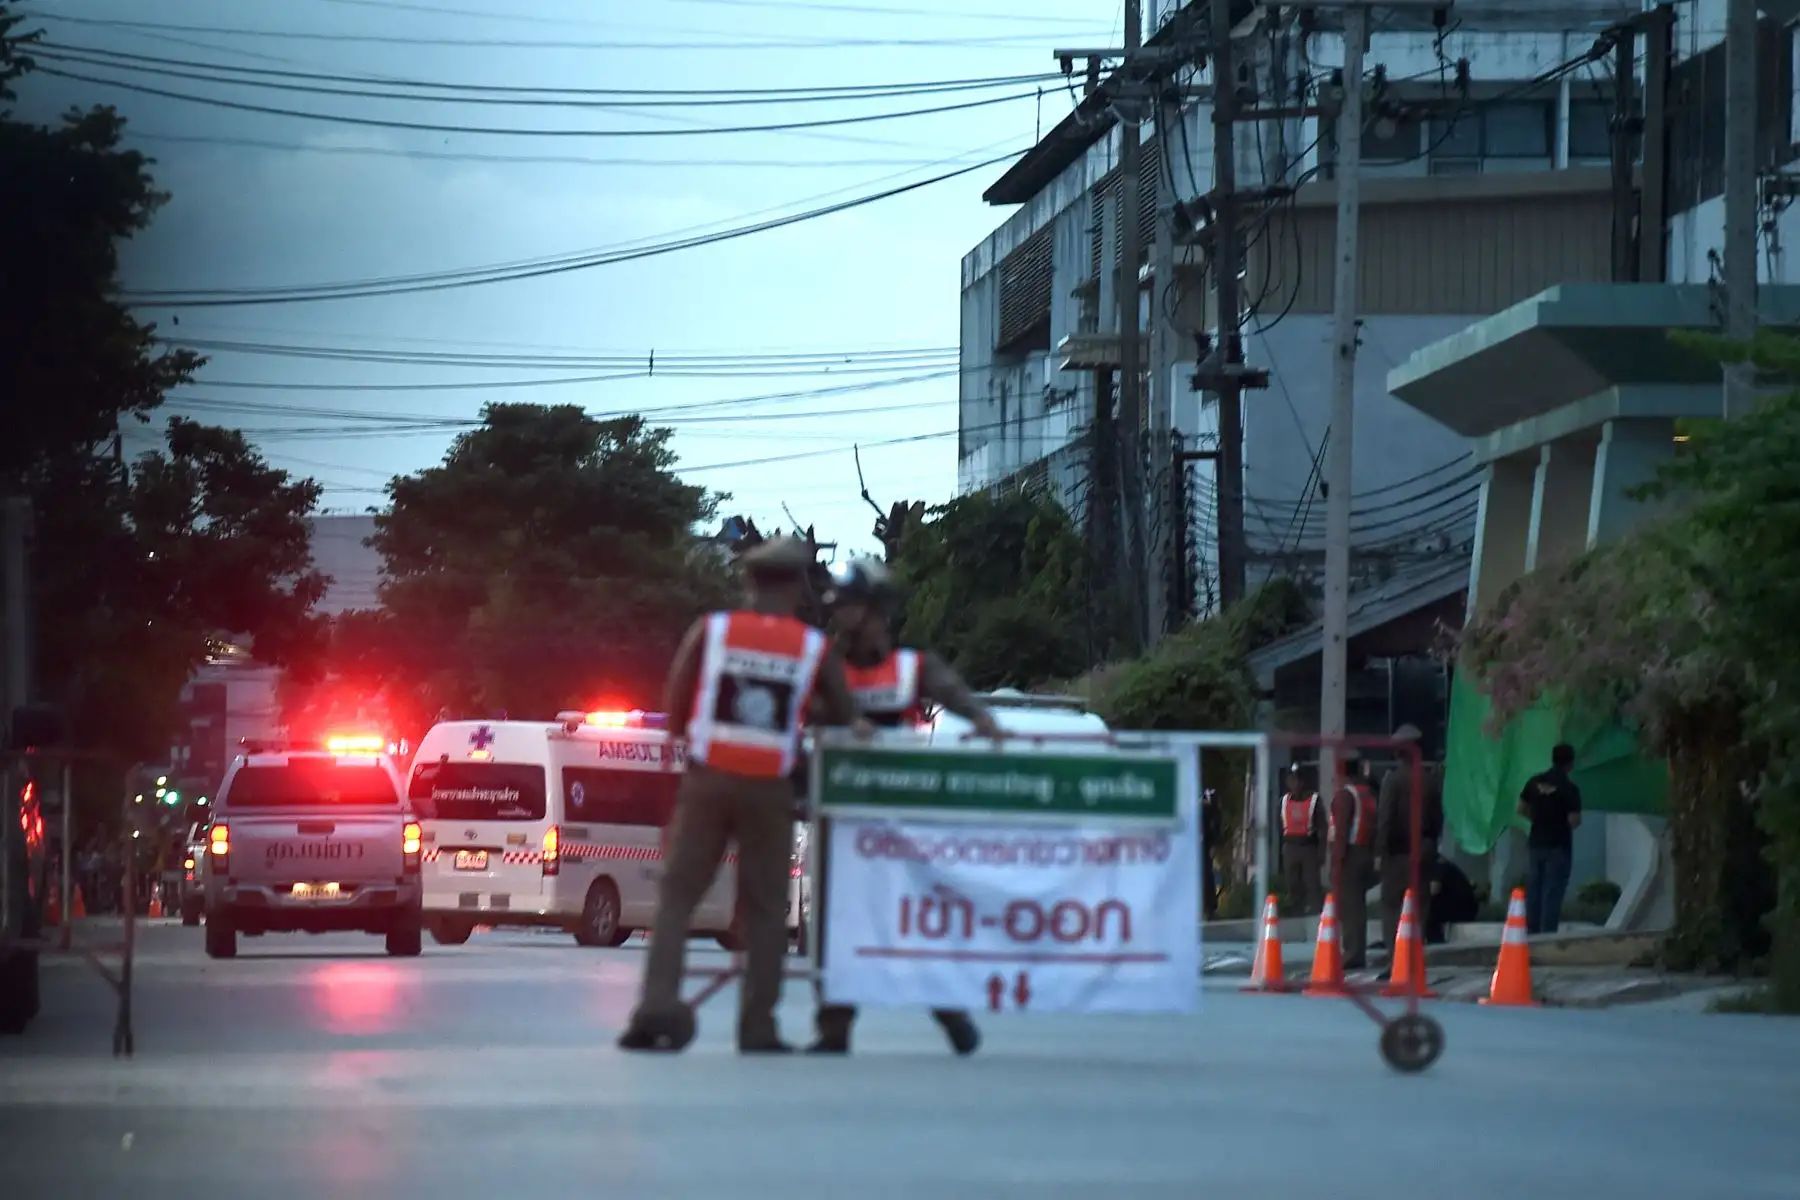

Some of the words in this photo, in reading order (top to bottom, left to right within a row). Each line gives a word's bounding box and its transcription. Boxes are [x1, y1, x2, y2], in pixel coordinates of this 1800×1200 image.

[599, 741, 686, 763] AMBULAN
[898, 886, 1132, 943] เข้า-ออก
